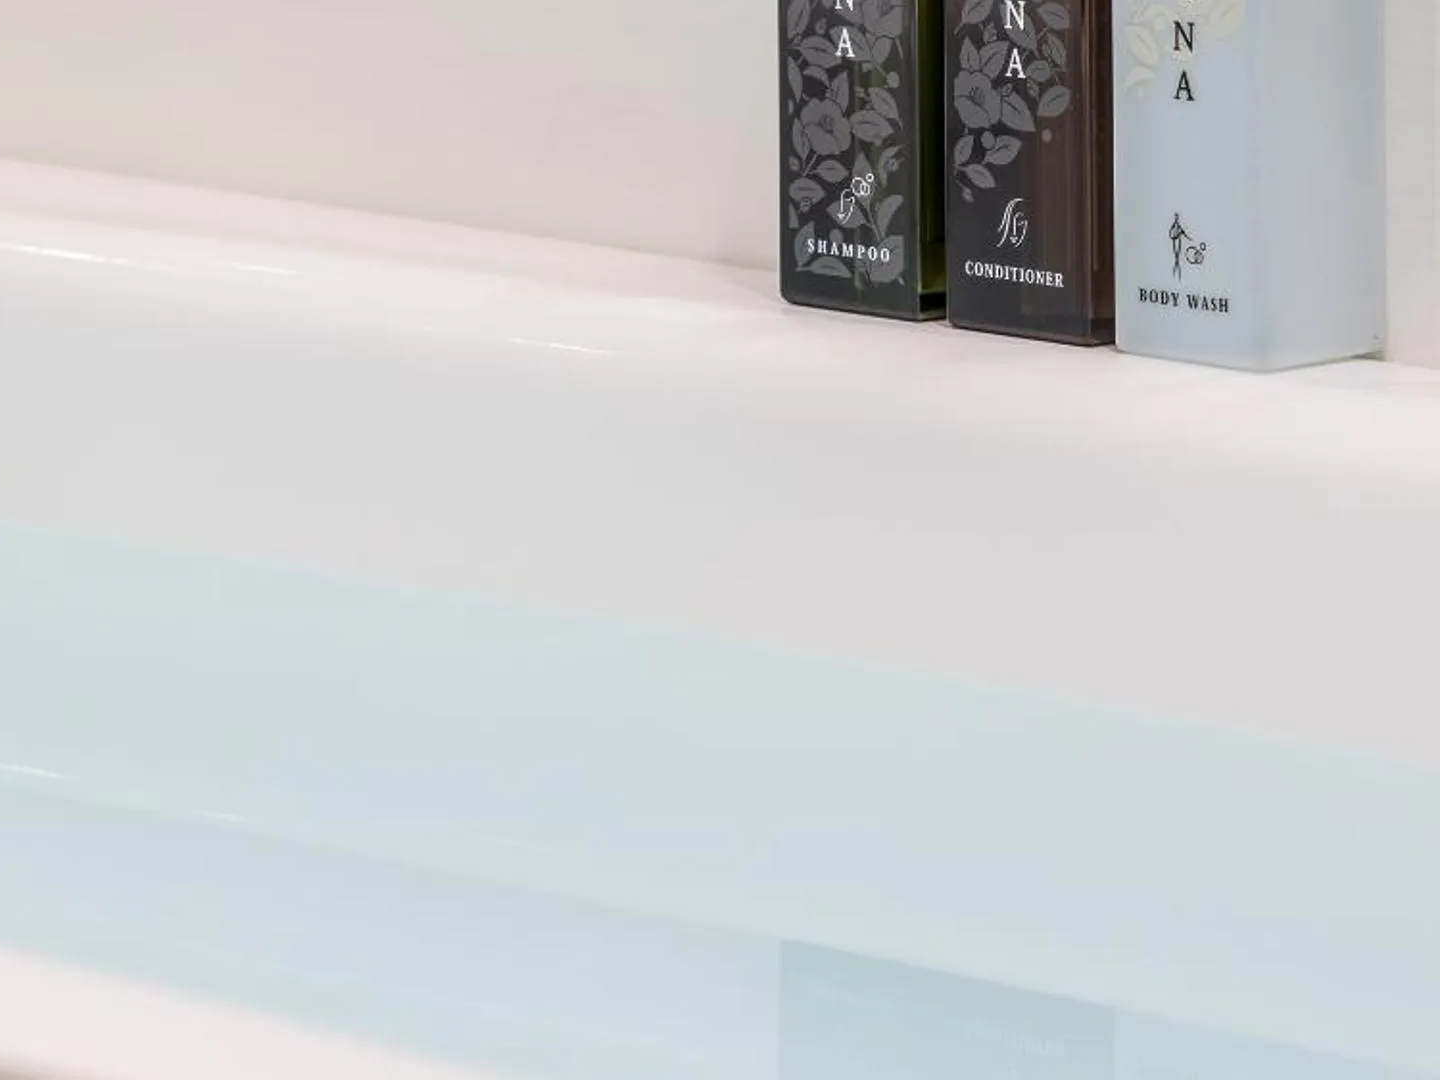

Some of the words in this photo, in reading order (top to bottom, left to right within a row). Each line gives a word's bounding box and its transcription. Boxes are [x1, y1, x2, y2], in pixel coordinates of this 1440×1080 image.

[806, 238, 891, 262] SHAMPOO
[964, 260, 1064, 288] CONDITIONER
[1138, 287, 1180, 308] BODY
[1187, 293, 1230, 313] WASH
